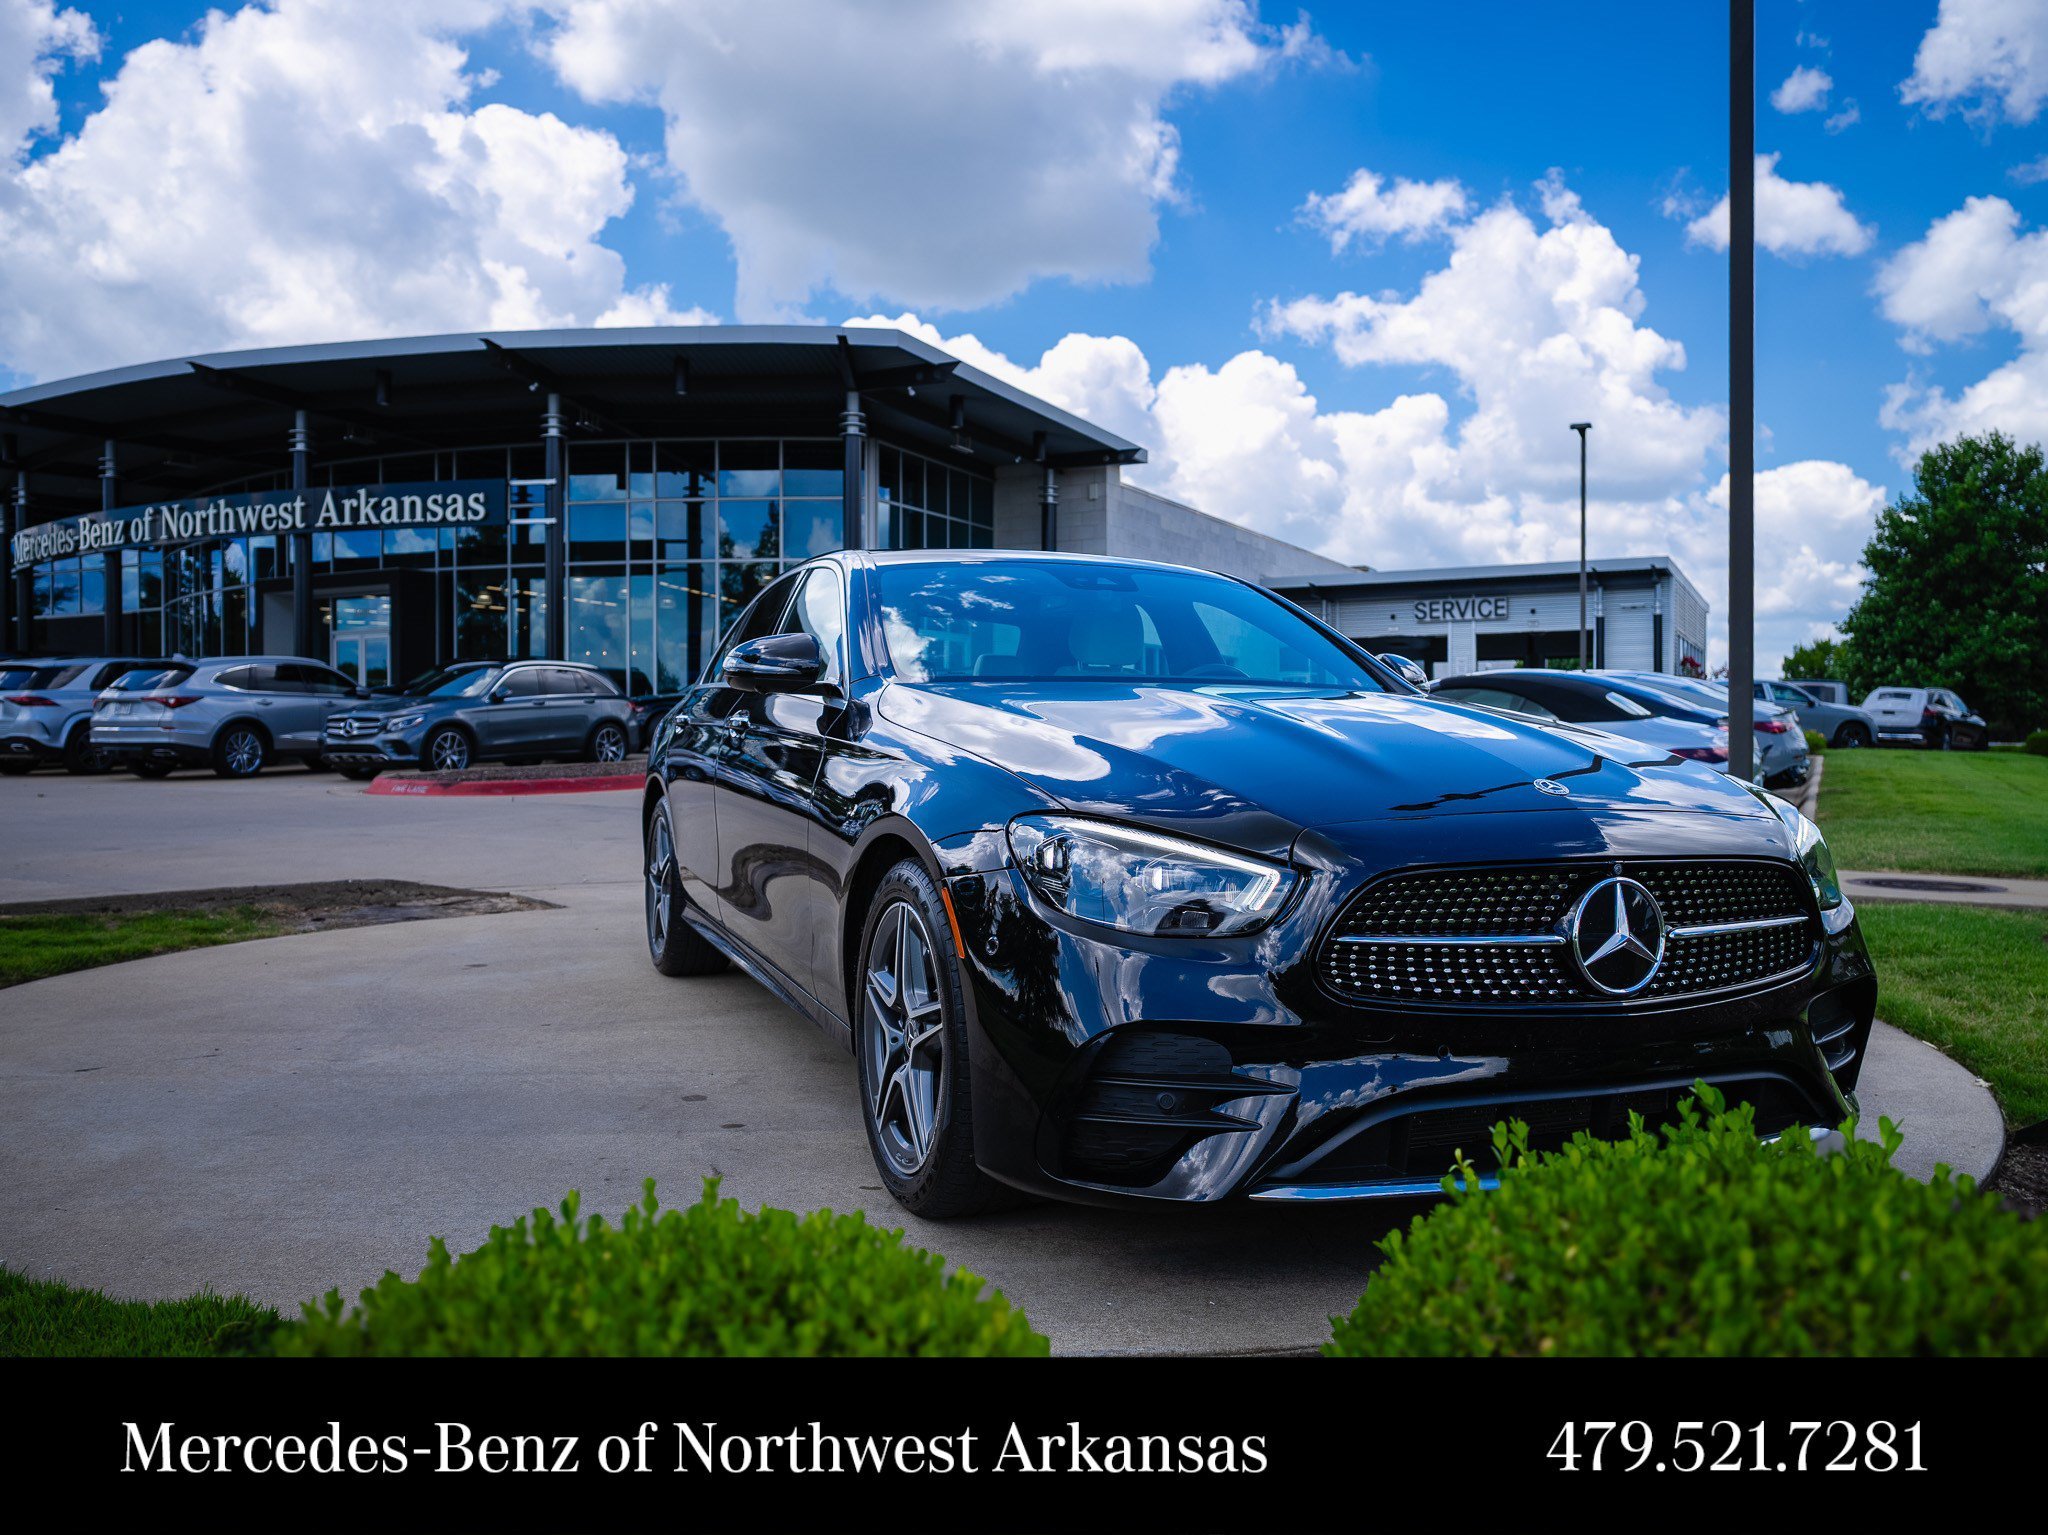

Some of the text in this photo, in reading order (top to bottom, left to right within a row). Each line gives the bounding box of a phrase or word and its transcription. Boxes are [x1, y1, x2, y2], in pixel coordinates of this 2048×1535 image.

[13, 488, 487, 566] Mercedes-Benz of Northwest Arkansas
[1414, 598, 1506, 620] SERVICE
